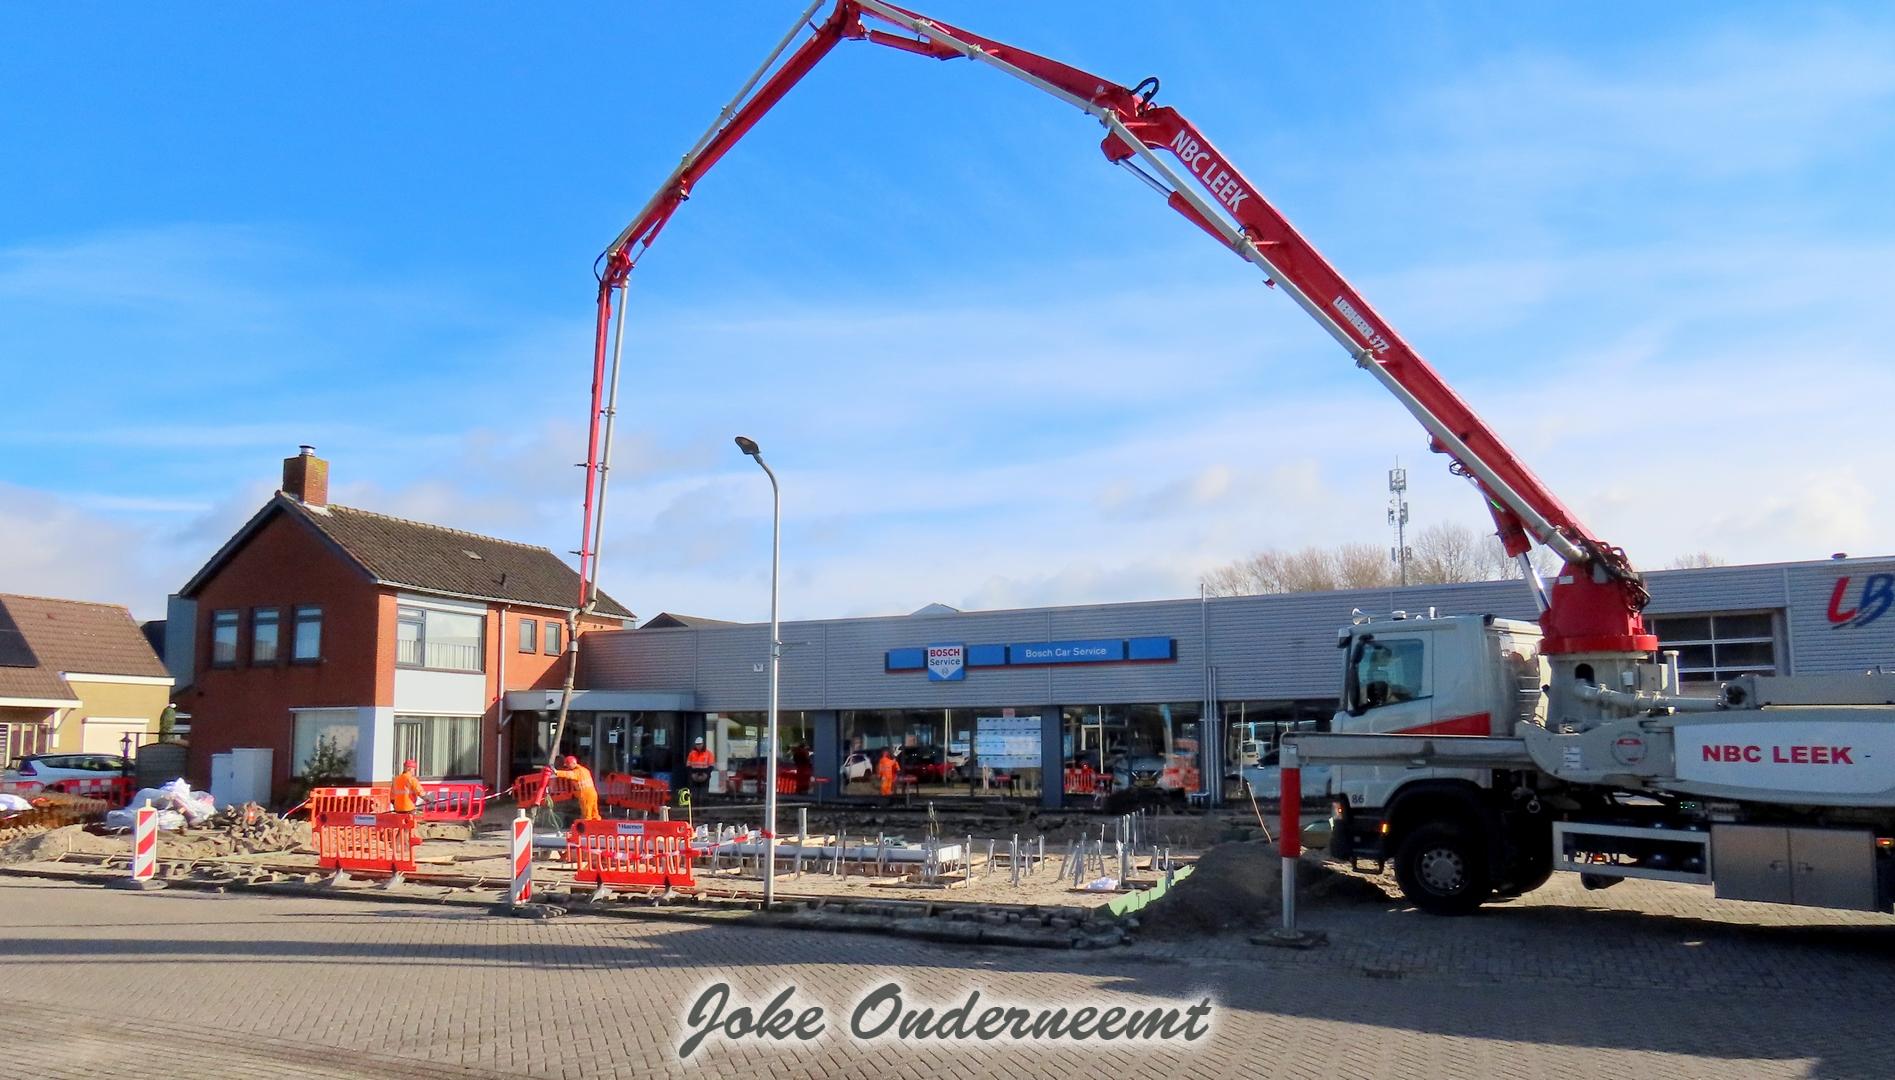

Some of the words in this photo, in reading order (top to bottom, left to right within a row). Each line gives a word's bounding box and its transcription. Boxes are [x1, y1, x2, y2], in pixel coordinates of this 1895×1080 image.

[1170, 130, 1210, 173] NBC
[1201, 162, 1248, 213] LEEK
[930, 648, 961, 657] BOSCH
[1025, 648, 1053, 658] Bosch
[1055, 648, 1070, 657] Car
[1073, 647, 1107, 656] Service
[930, 658, 961, 666] Service
[1702, 744, 1762, 763] NBC
[1773, 745, 1854, 765] LEEK
[1351, 794, 1365, 804] 86
